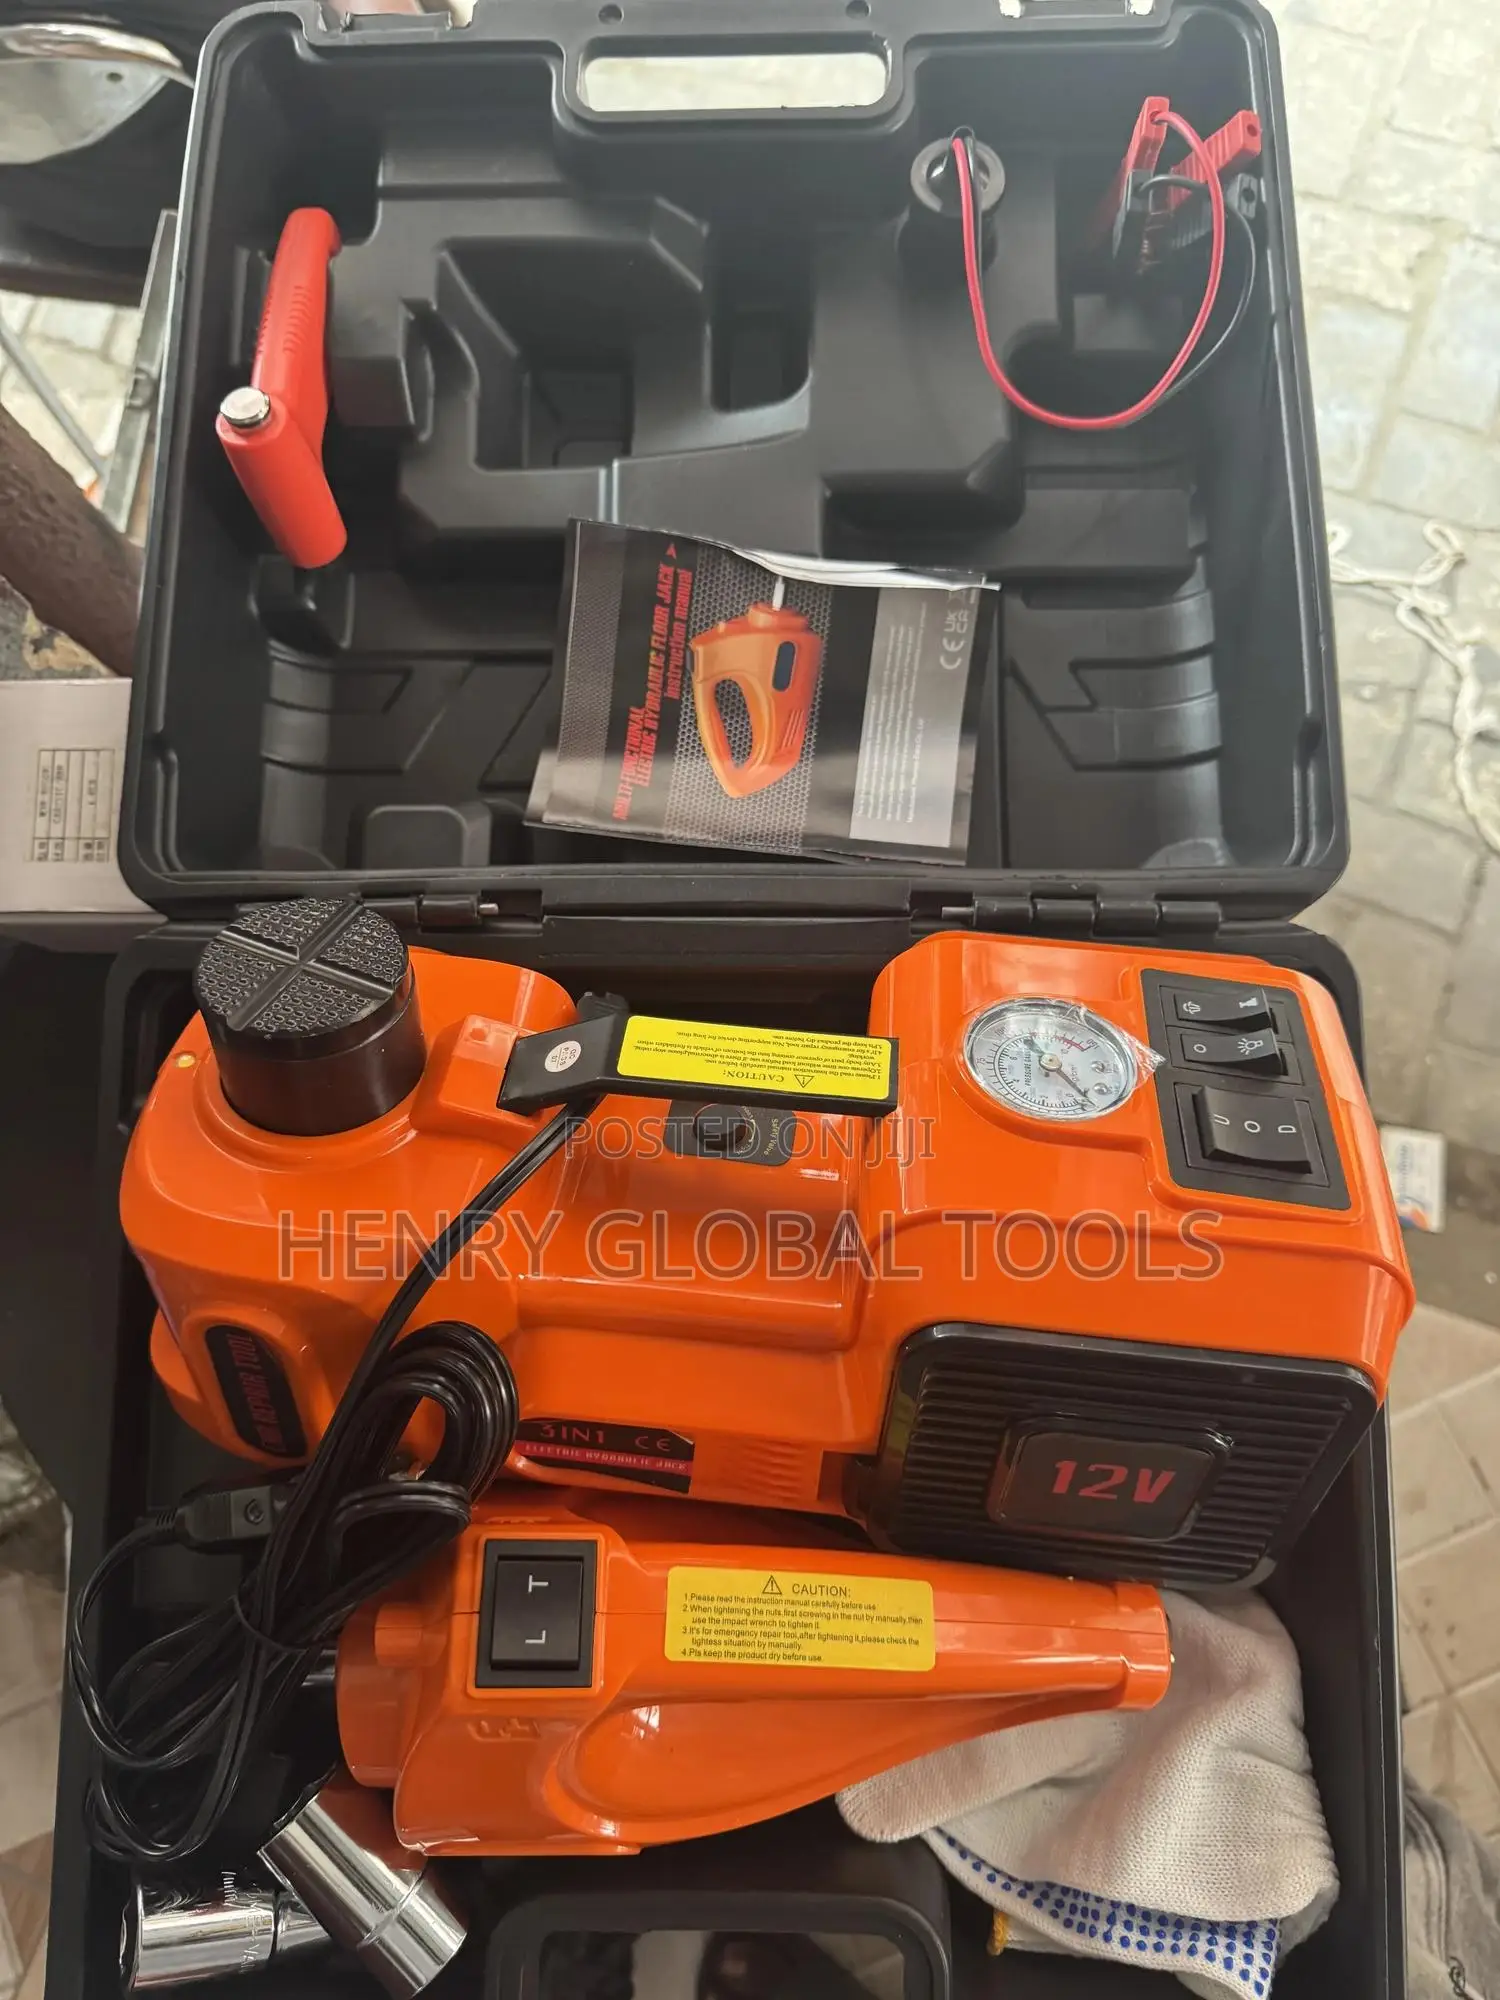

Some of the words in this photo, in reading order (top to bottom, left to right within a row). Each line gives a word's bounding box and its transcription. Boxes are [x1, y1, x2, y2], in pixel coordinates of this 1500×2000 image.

[656, 562, 675, 604] JACK
[674, 568, 693, 620] manual
[650, 604, 669, 652] FLOOR
[643, 650, 666, 731] HYDRAULIC
[612, 706, 645, 820] MULTI-FUNCTIONAL
[635, 729, 656, 787] ELECTRIC
[656, 1041, 685, 1050] forbidden
[738, 1037, 771, 1045] supporting
[817, 1039, 840, 1047] product
[772, 1052, 795, 1060] coming
[723, 1070, 784, 1082] CAUTION:
[1024, 1063, 1032, 1087] PRESSURE
[771, 1118, 779, 1138] Safety
[764, 1139, 777, 1156] Valve
[540, 1424, 605, 1444] 3IN1
[635, 1435, 671, 1451] CE
[525, 1444, 581, 1457] ELECTRIC
[586, 1452, 650, 1467] HYDRAULIC
[656, 1461, 687, 1472] JACK
[1052, 1460, 1176, 1503] 12V
[528, 1574, 549, 1593] T
[792, 1583, 851, 1597] CAUTION:
[717, 1595, 732, 1603] read
[747, 1596, 783, 1604] instruction
[811, 1600, 839, 1609] carefully
[841, 1601, 862, 1609] before
[708, 1617, 720, 1625] the
[722, 1618, 748, 1626] impact
[779, 1620, 785, 1628] to
[788, 1620, 813, 1629] tighten
[713, 1606, 750, 1616] tightening
[752, 1607, 764, 1615] the
[799, 1611, 831, 1620] screwing
[840, 1612, 851, 1620] the
[866, 1614, 874, 1623] by
[525, 1630, 546, 1644] L
[692, 1637, 722, 1647] tightess
[724, 1639, 755, 1648] situation
[757, 1640, 767, 1650] by
[817, 1632, 853, 1643] tightening
[887, 1637, 908, 1645] check
[908, 1637, 919, 1645] the
[703, 1650, 722, 1660] keep
[724, 1650, 736, 1659] the
[738, 1651, 767, 1662] product
[769, 1652, 781, 1662] dry
[782, 1653, 807, 1662] before
